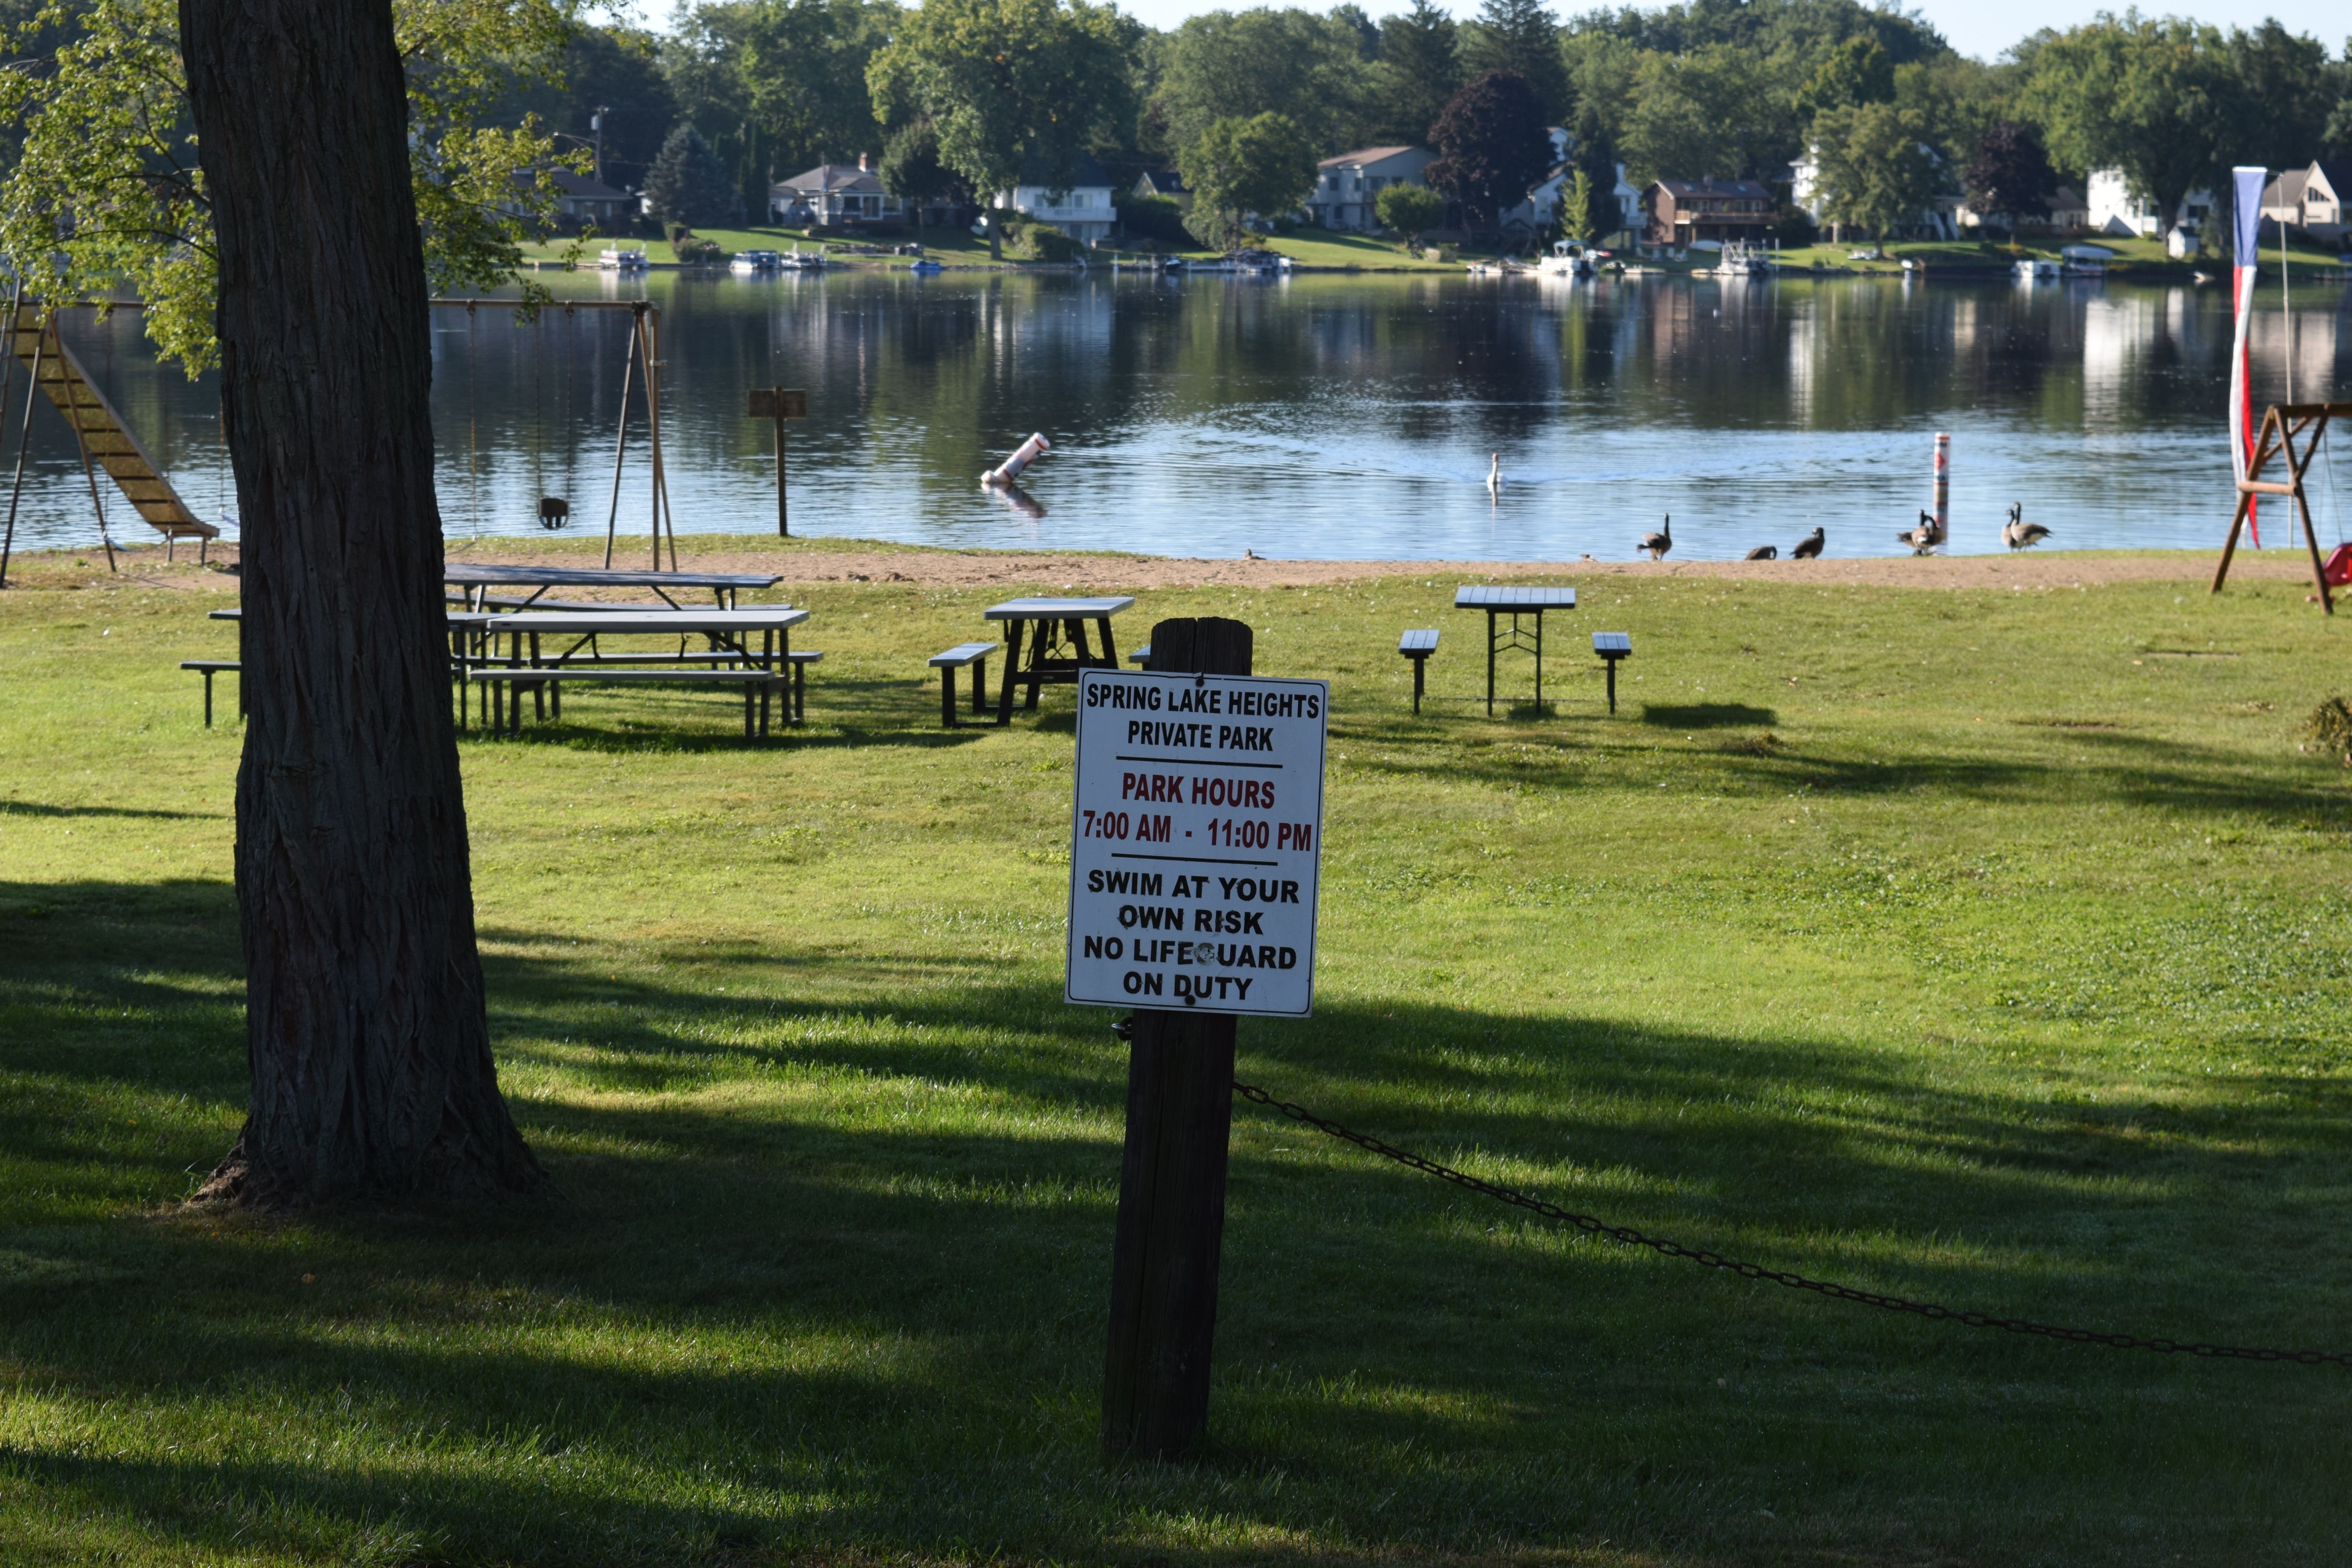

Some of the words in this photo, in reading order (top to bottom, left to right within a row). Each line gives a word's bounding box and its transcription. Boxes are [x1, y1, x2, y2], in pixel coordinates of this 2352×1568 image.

[1087, 684, 1161, 711] SPRING
[1168, 689, 1221, 714] LAKE
[1228, 691, 1319, 719] HEIGHTS
[1128, 720, 1212, 748] PRIVATE
[1219, 725, 1274, 751] PARK
[1122, 772, 1185, 804] PARK
[1191, 777, 1275, 809] HOURS
[1083, 810, 1129, 840] 7:00
[1135, 814, 1171, 843] AM
[1208, 818, 1269, 849] 11:00
[1277, 822, 1312, 851] PM
[1087, 869, 1162, 897] SWIM
[1171, 875, 1209, 898] AT
[1218, 877, 1299, 904] YOUR
[1118, 905, 1185, 931] OWN
[1194, 909, 1264, 935] RISK
[1084, 935, 1123, 960] NO
[1123, 971, 1163, 996] ON
[1174, 974, 1253, 1000] DUTY
